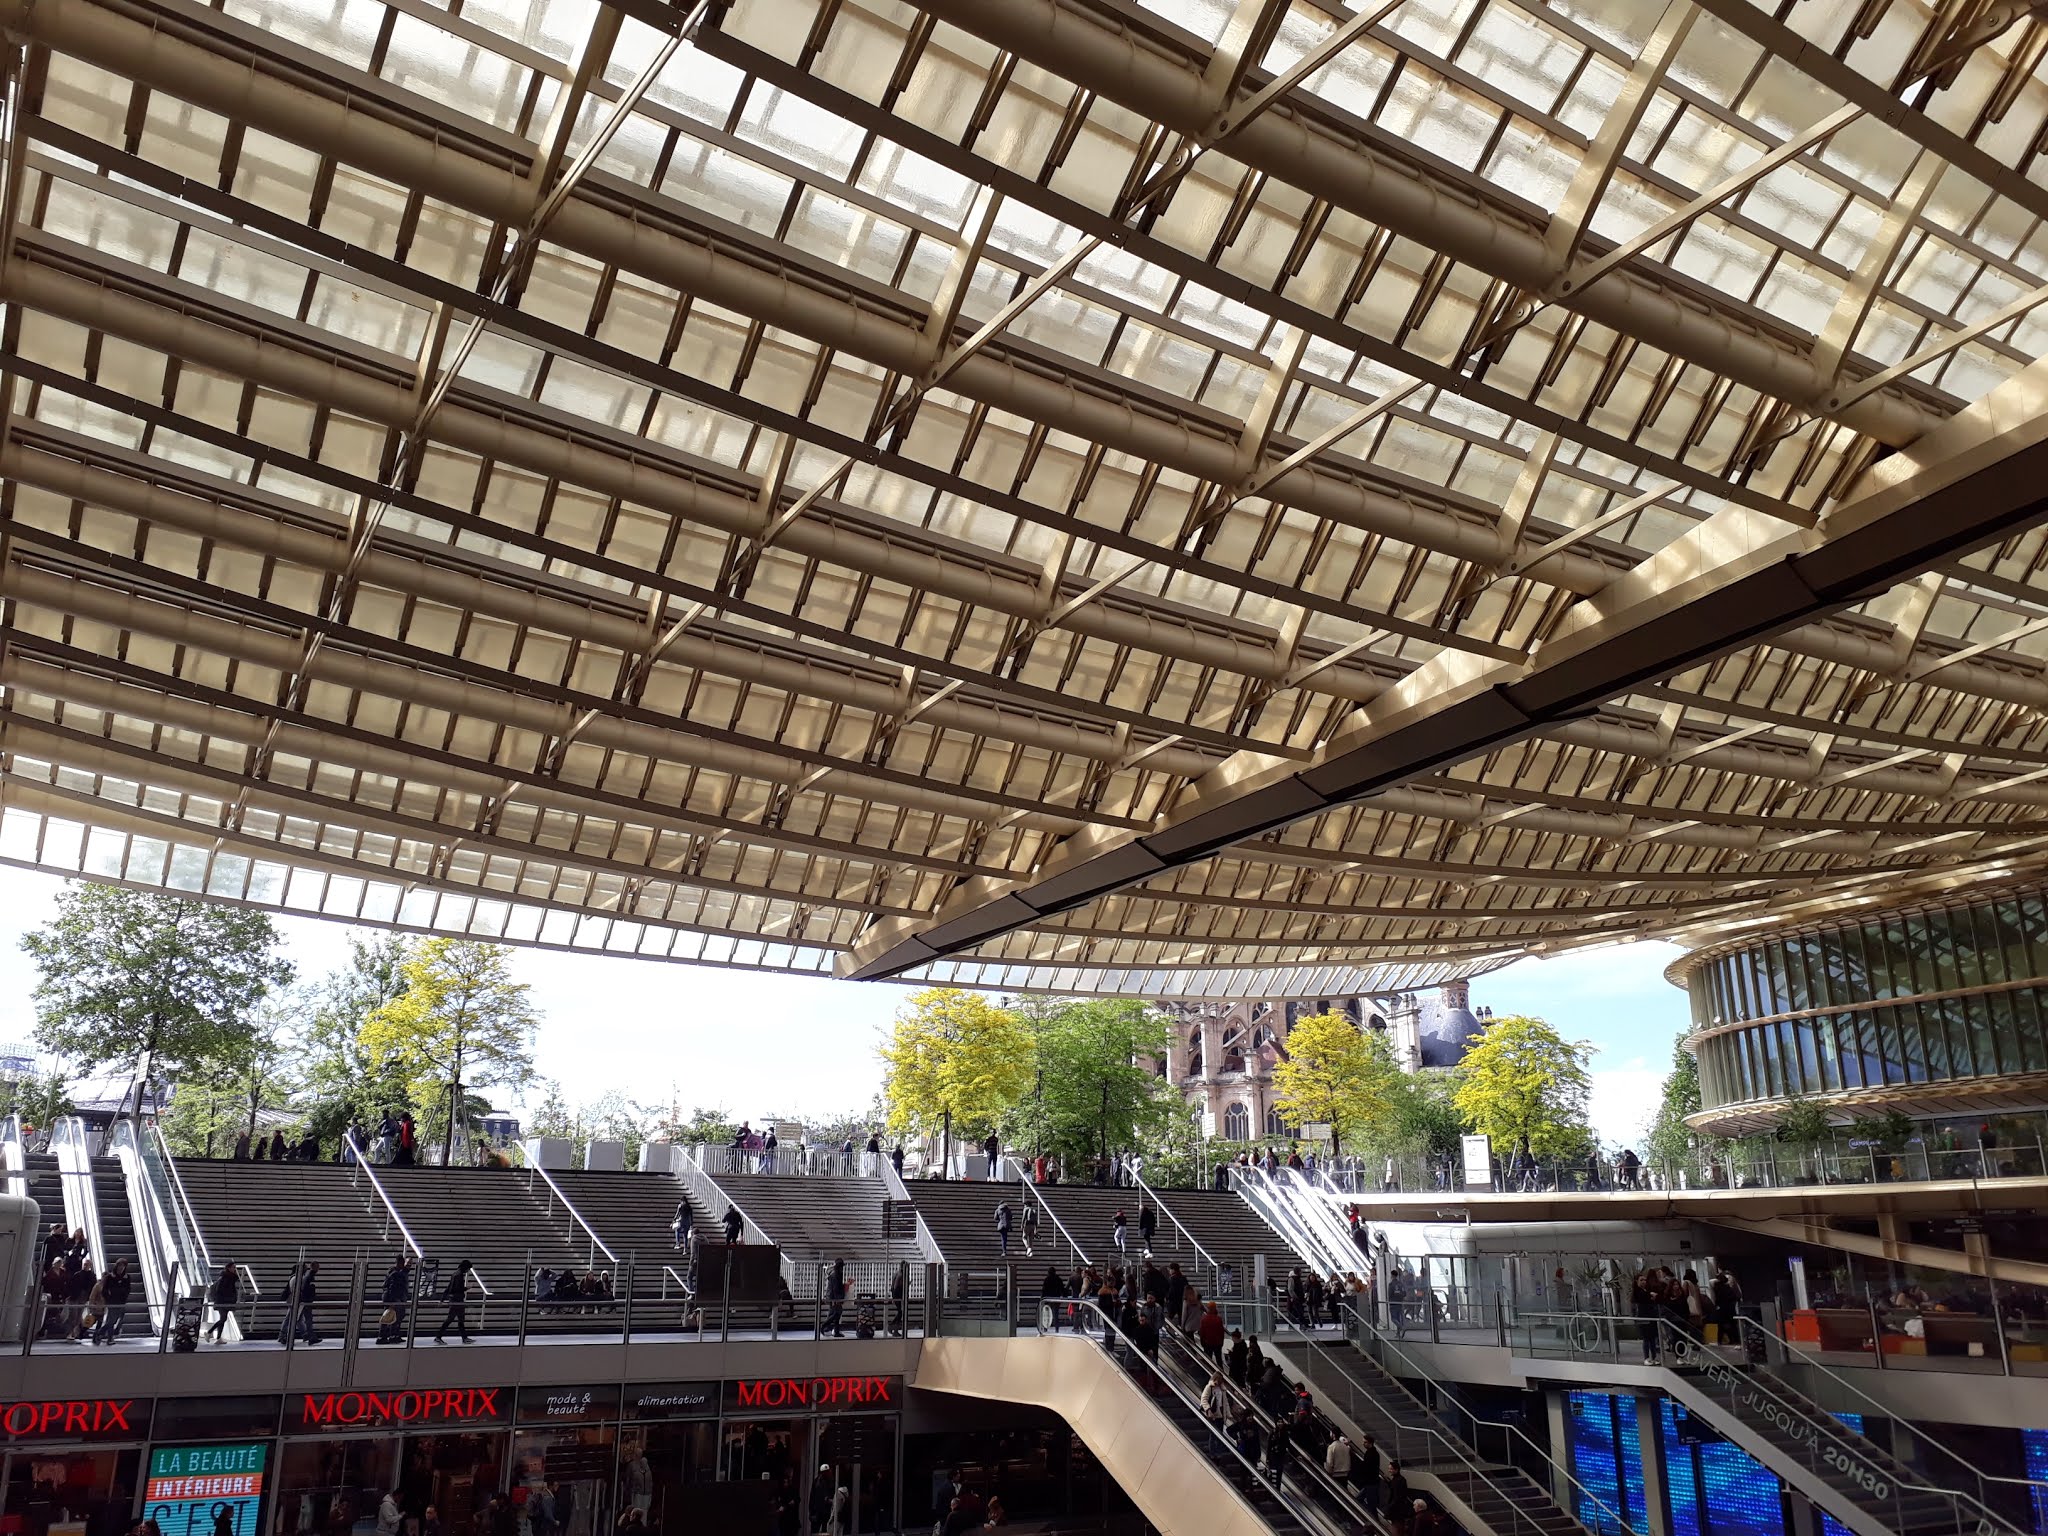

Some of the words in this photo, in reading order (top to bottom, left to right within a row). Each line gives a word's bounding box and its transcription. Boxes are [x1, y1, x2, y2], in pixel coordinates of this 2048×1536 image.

[303, 1387, 499, 1424] MONOPRIX
[547, 1392, 577, 1405] mode
[582, 1392, 592, 1404] &
[638, 1394, 705, 1406] alimentation
[737, 1376, 892, 1407] MONOPRIX
[0, 1400, 134, 1436] OPRIX
[547, 1403, 586, 1415] beauté
[1674, 1341, 1742, 1394] OUVERT
[1742, 1392, 1819, 1455] JUSQU'À
[1823, 1446, 1889, 1500] 20H30
[158, 1453, 181, 1473] LA
[188, 1445, 259, 1472] BEAUTÉ
[154, 1476, 255, 1498] INTÉRIEURE
